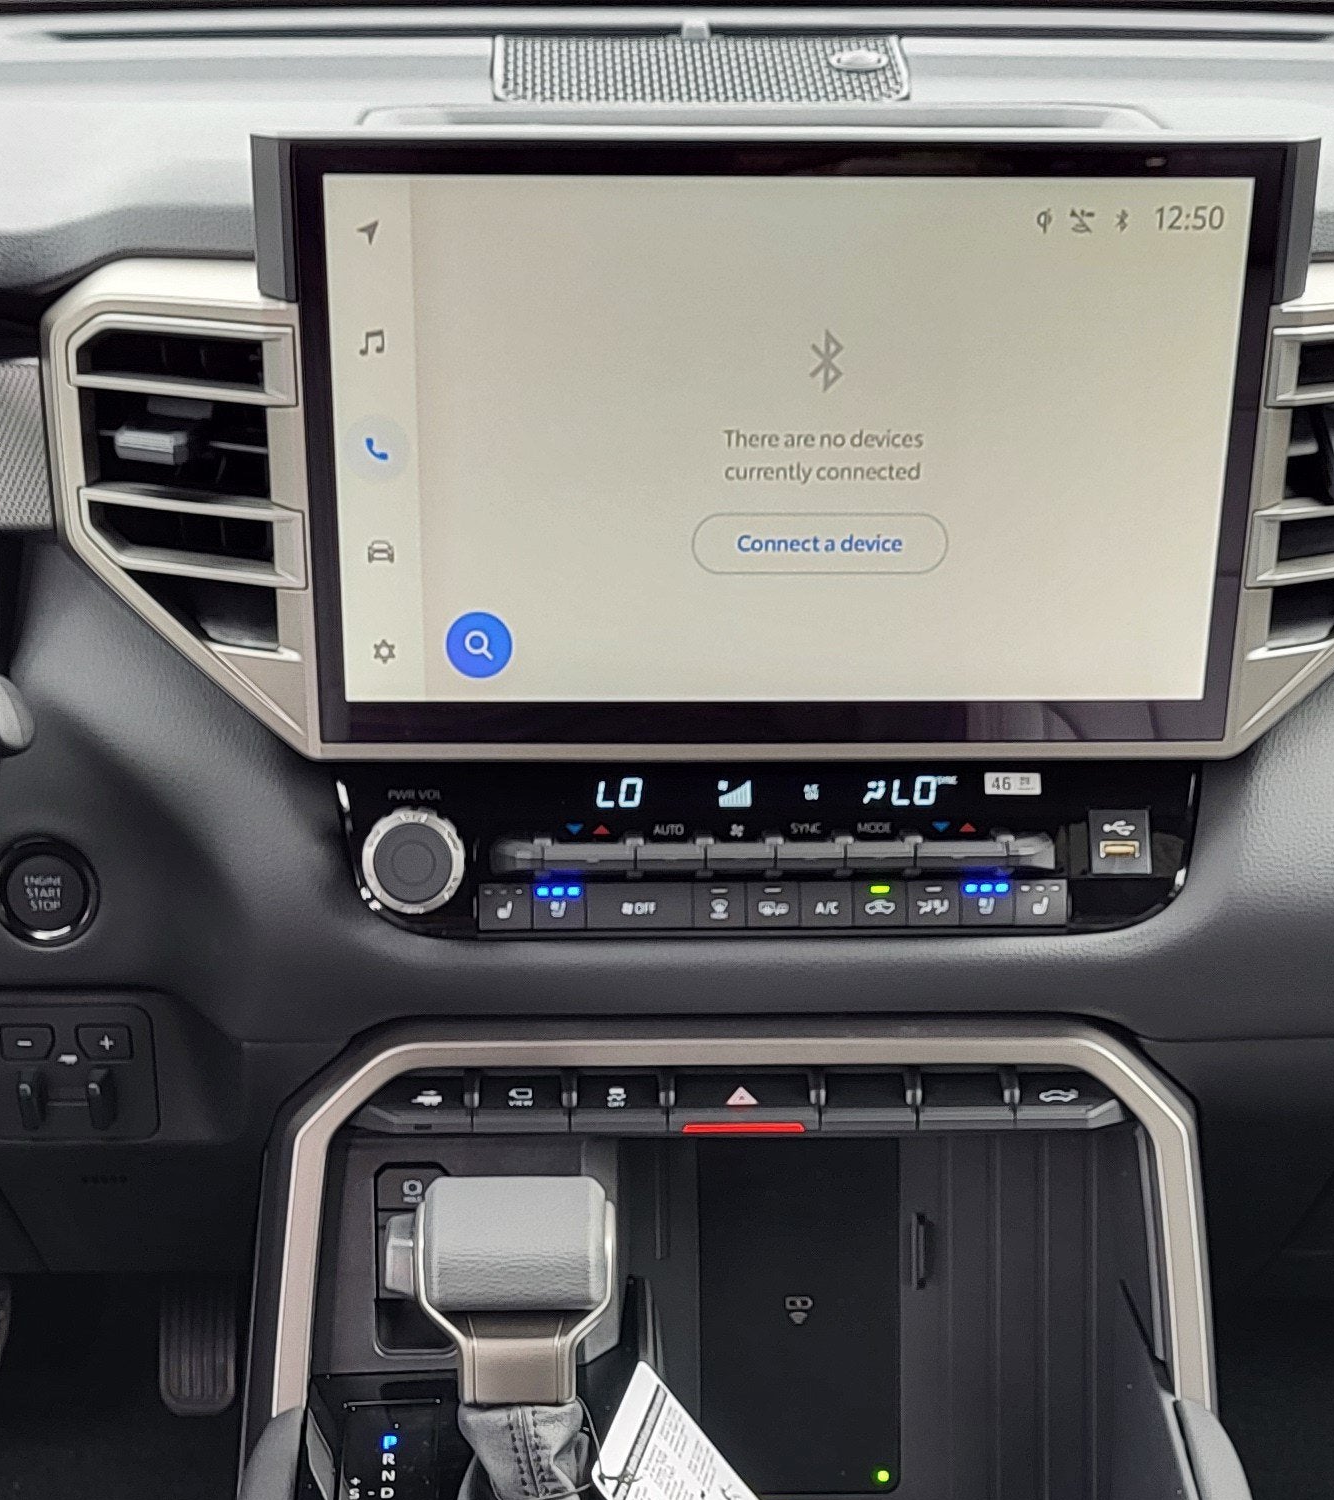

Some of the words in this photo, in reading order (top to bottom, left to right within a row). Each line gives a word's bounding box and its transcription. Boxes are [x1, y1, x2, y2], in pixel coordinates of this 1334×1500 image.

[1155, 205, 1225, 230] 12:50
[724, 429, 779, 448] There
[784, 433, 815, 448] are
[820, 433, 846, 448] no
[850, 429, 924, 448] devices
[724, 462, 813, 485] currently
[816, 462, 921, 481] connected
[736, 534, 820, 553] Connect
[824, 539, 835, 552] a
[840, 533, 903, 552] device
[991, 776, 1012, 791] 46
[595, 777, 644, 808] LO
[890, 776, 938, 807] LO
[653, 823, 685, 836] AUTO
[790, 821, 822, 834] SYNC
[856, 822, 892, 834] MODE
[25, 887, 62, 899] START
[30, 900, 61, 912] STOP
[634, 901, 656, 915] OFF
[814, 901, 840, 914] A/C
[383, 1435, 398, 1450] P
[382, 1453, 396, 1466] R
[381, 1469, 396, 1482] N
[348, 1487, 360, 1500] S
[380, 1487, 395, 1499] D
